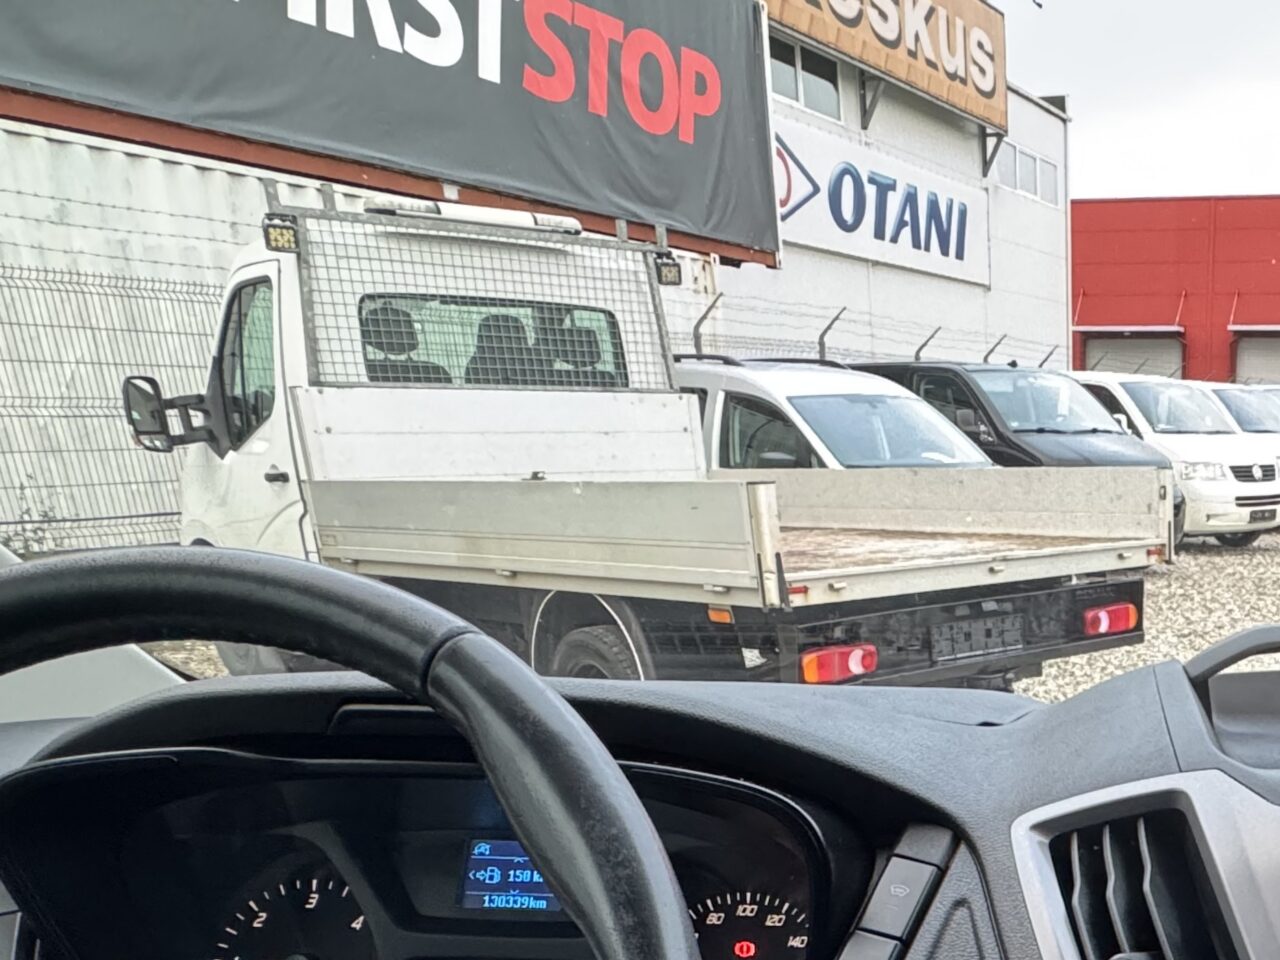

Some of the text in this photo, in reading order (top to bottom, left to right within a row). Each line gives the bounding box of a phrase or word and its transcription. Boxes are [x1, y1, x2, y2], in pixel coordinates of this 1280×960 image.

[522, 0, 721, 144] STOP
[828, 160, 968, 261] OTANI
[507, 870, 530, 882] 150
[253, 912, 267, 927] 2
[305, 893, 319, 909] 3
[350, 915, 365, 931] 4
[706, 905, 807, 948] 80 100 120 140
